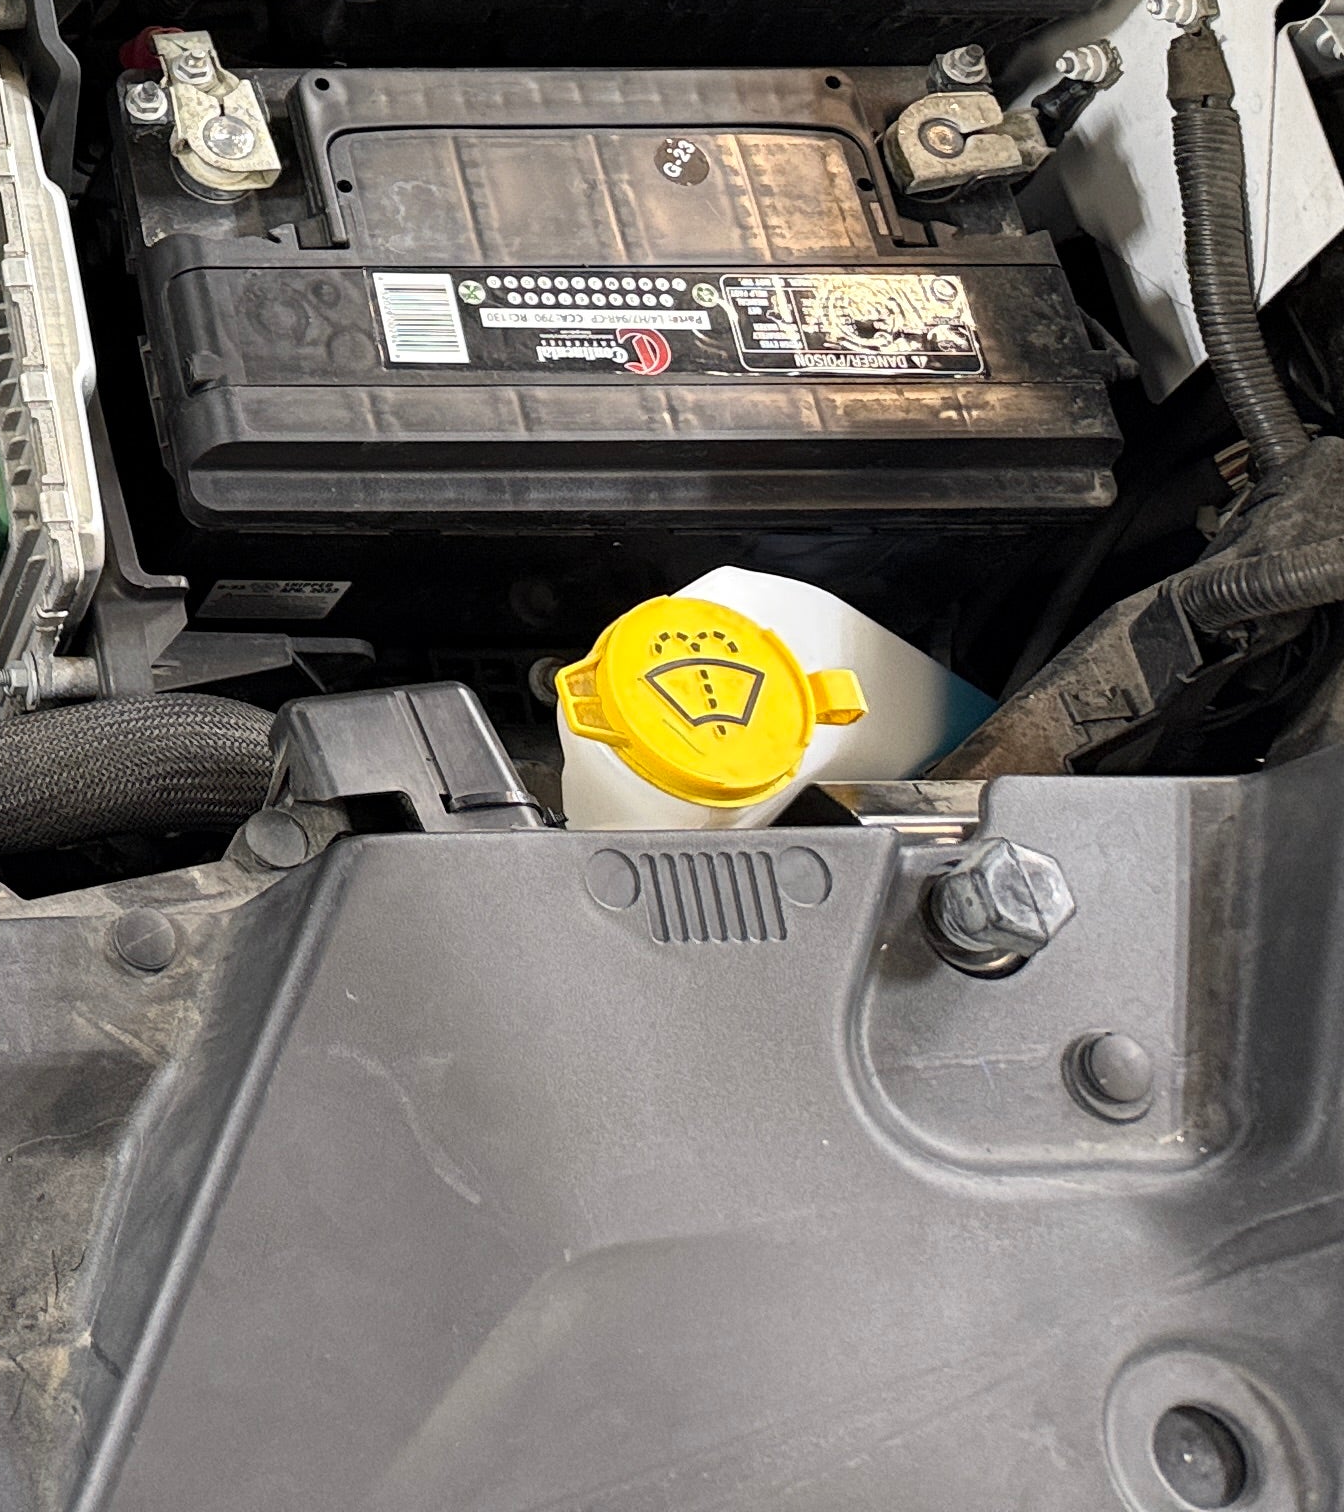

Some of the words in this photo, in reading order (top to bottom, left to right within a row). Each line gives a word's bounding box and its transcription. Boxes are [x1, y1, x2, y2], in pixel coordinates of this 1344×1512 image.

[661, 137, 697, 180] G-23
[486, 312, 507, 323] 130
[534, 313, 554, 324] 790
[793, 353, 908, 368] DANGER/POISON
